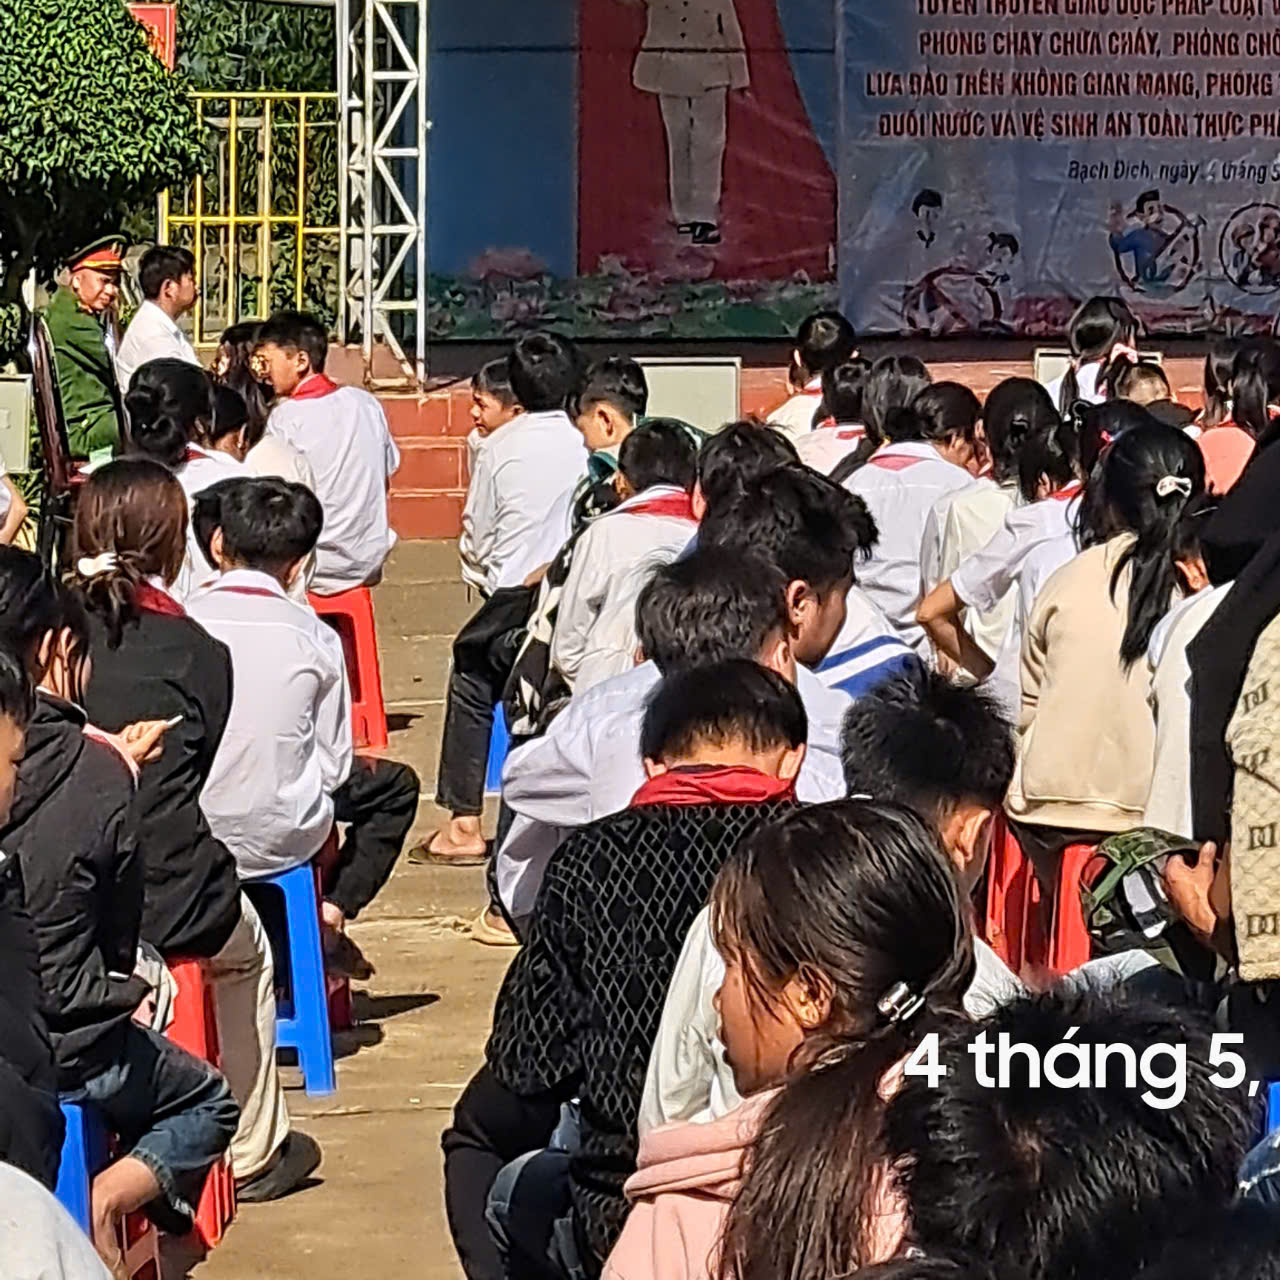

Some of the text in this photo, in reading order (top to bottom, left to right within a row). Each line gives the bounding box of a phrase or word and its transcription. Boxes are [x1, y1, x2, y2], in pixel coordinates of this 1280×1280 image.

[1011, 67, 1077, 97] KHÔNG
[1083, 71, 1132, 97] GIAN
[1022, 107, 1045, 142] VỆ
[1051, 111, 1098, 137] SINH
[1104, 111, 1132, 137] AN
[1068, 160, 1108, 183] Bạch
[1159, 160, 1200, 184] ngày
